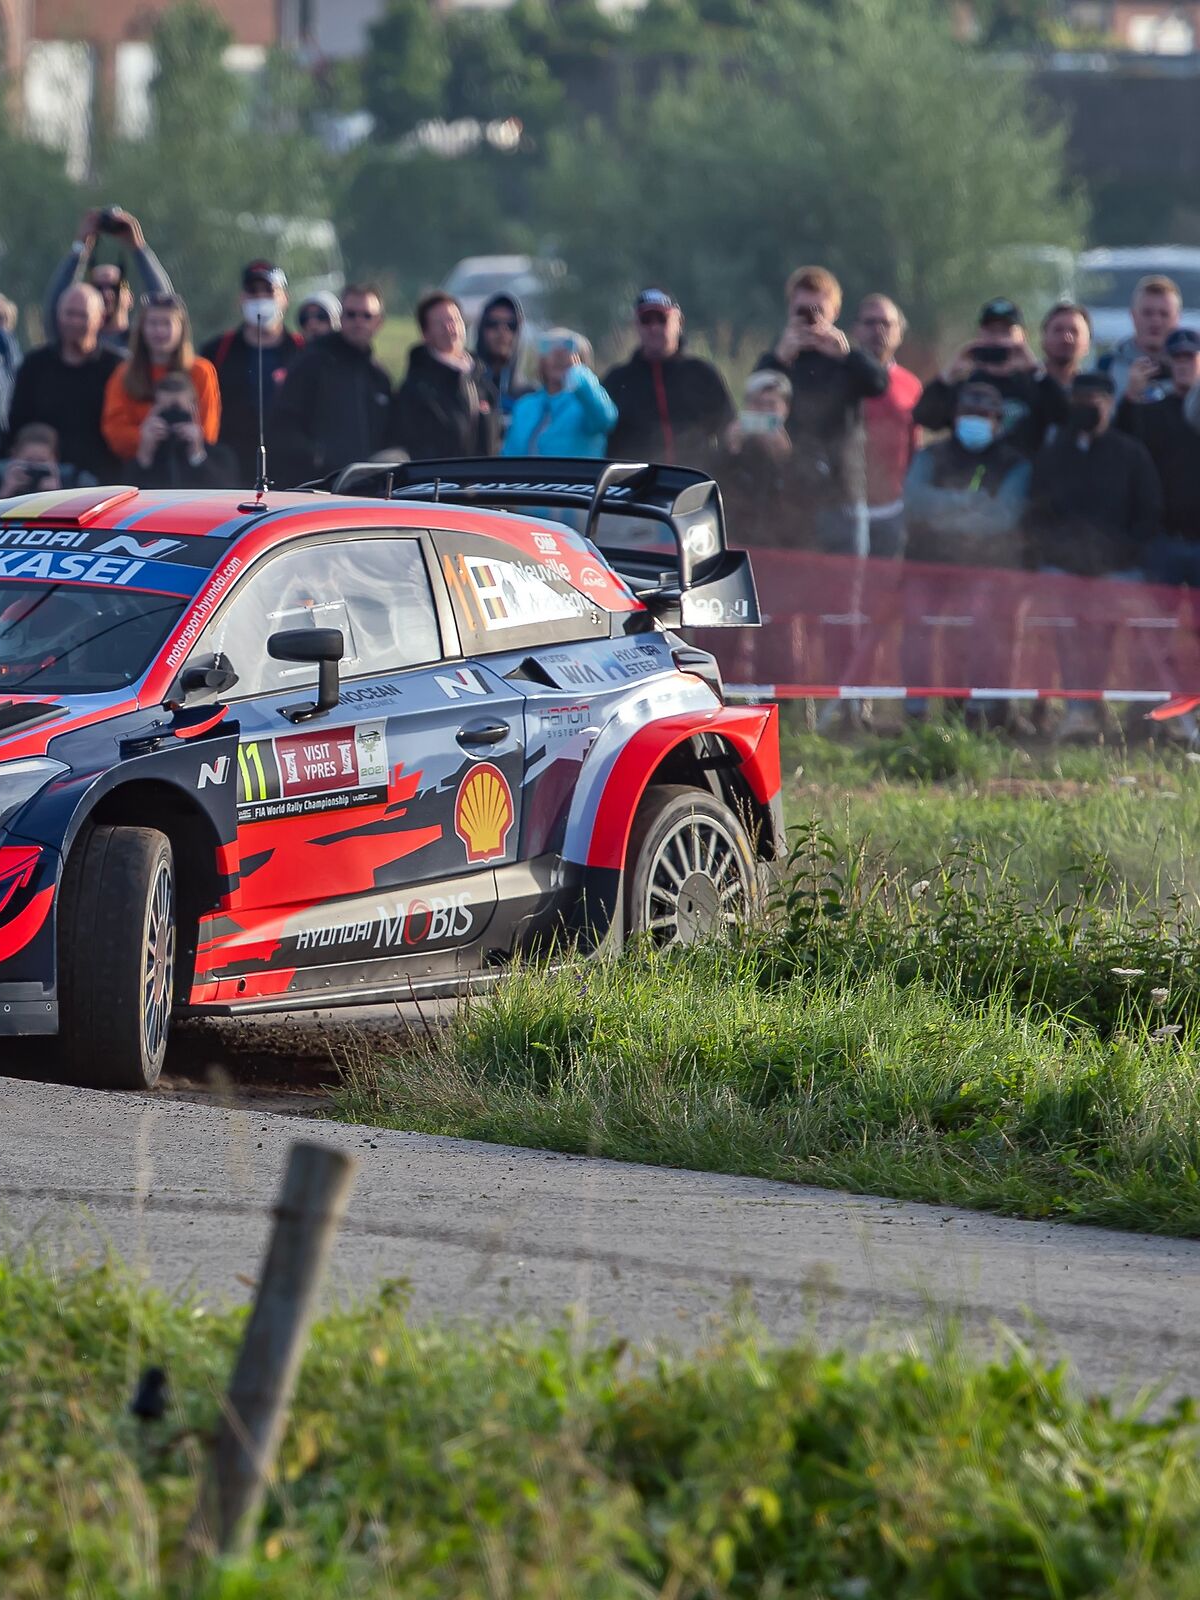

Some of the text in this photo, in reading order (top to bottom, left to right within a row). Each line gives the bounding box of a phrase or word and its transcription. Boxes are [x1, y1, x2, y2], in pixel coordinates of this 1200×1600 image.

[511, 558, 572, 584] Neuville
[165, 556, 242, 668] motorsport.hyundai.com
[613, 644, 661, 661] HYUNDAI
[557, 660, 605, 684] WIA
[625, 660, 660, 675] STEEL
[340, 683, 403, 705] NOCEAN
[547, 726, 585, 738] SYSTEM
[303, 743, 330, 761] VISIT
[303, 761, 337, 780] YPRES
[255, 795, 350, 818] FIA World Rally Championship
[296, 891, 474, 950] HYUNDAI MOBIS
